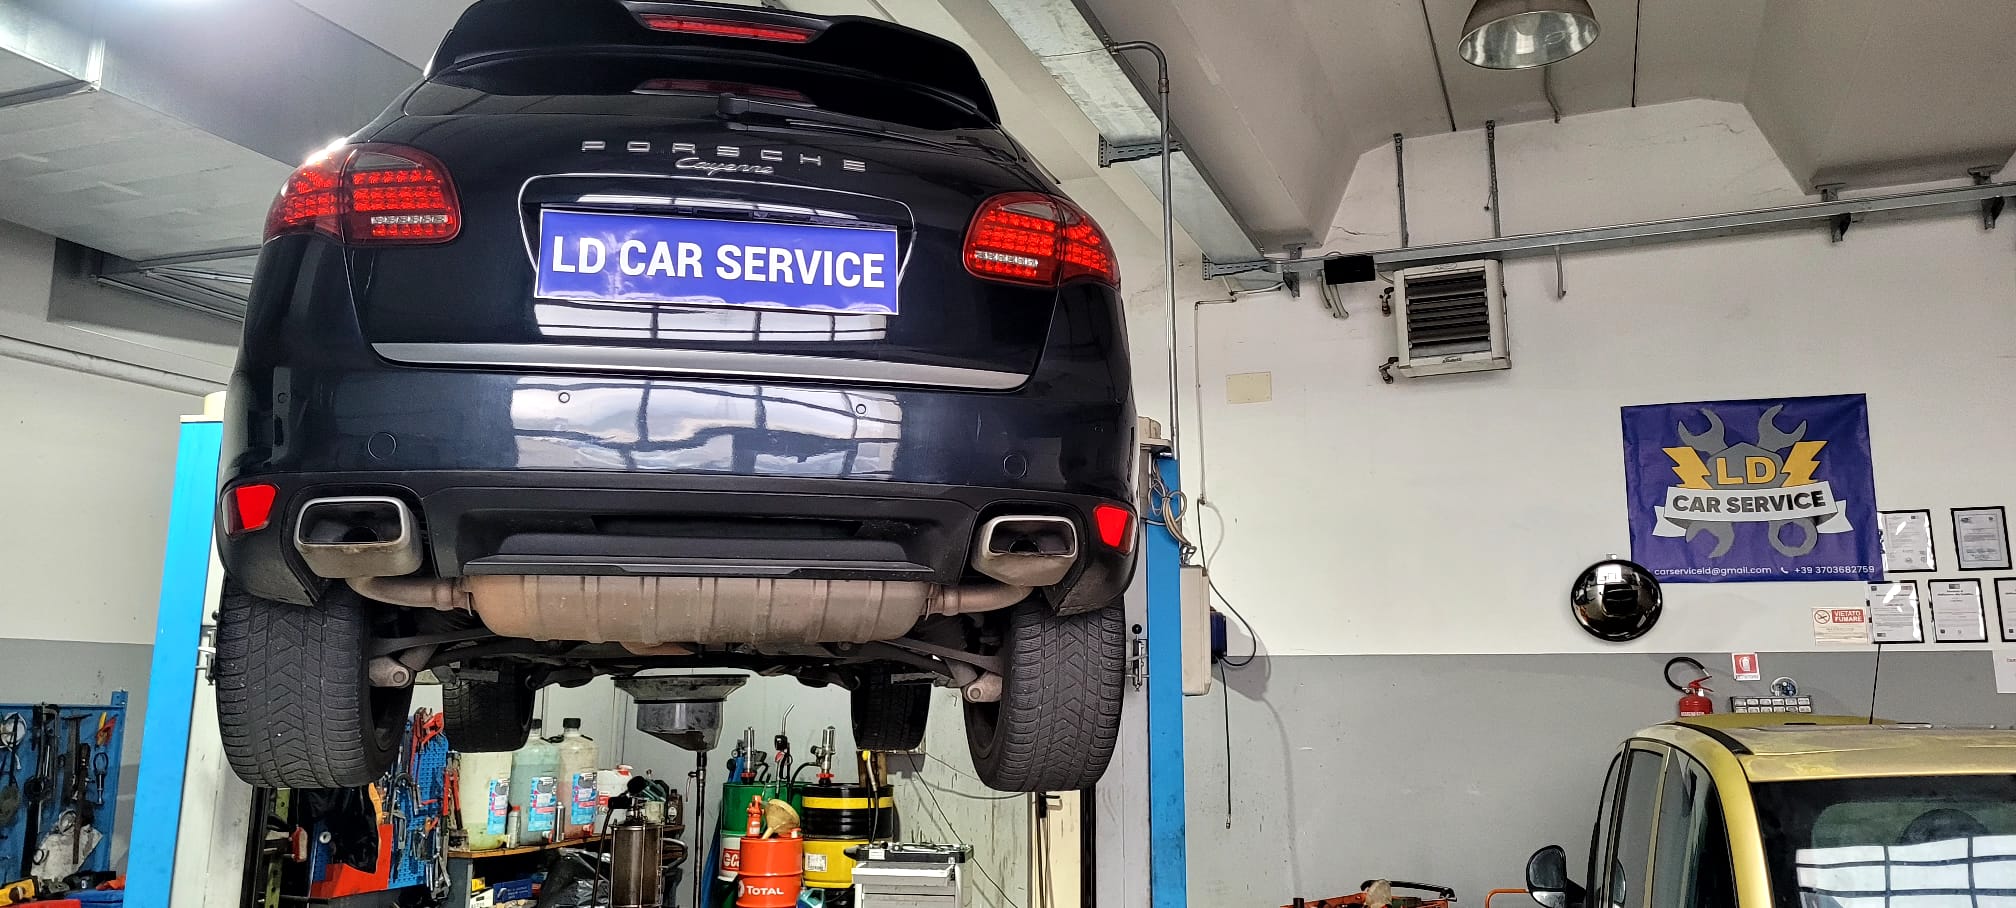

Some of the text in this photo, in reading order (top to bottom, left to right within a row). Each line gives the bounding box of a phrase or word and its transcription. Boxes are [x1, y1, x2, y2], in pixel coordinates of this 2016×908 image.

[581, 141, 866, 172] PORSCHE
[674, 157, 774, 176] Cayenne
[552, 236, 886, 289] LD CAR SERVICE
[1716, 456, 1777, 485] LD
[1672, 490, 1826, 513] CAR SERVICE
[1654, 565, 1875, 577] carserviceld@gmail.com +39 3703682759
